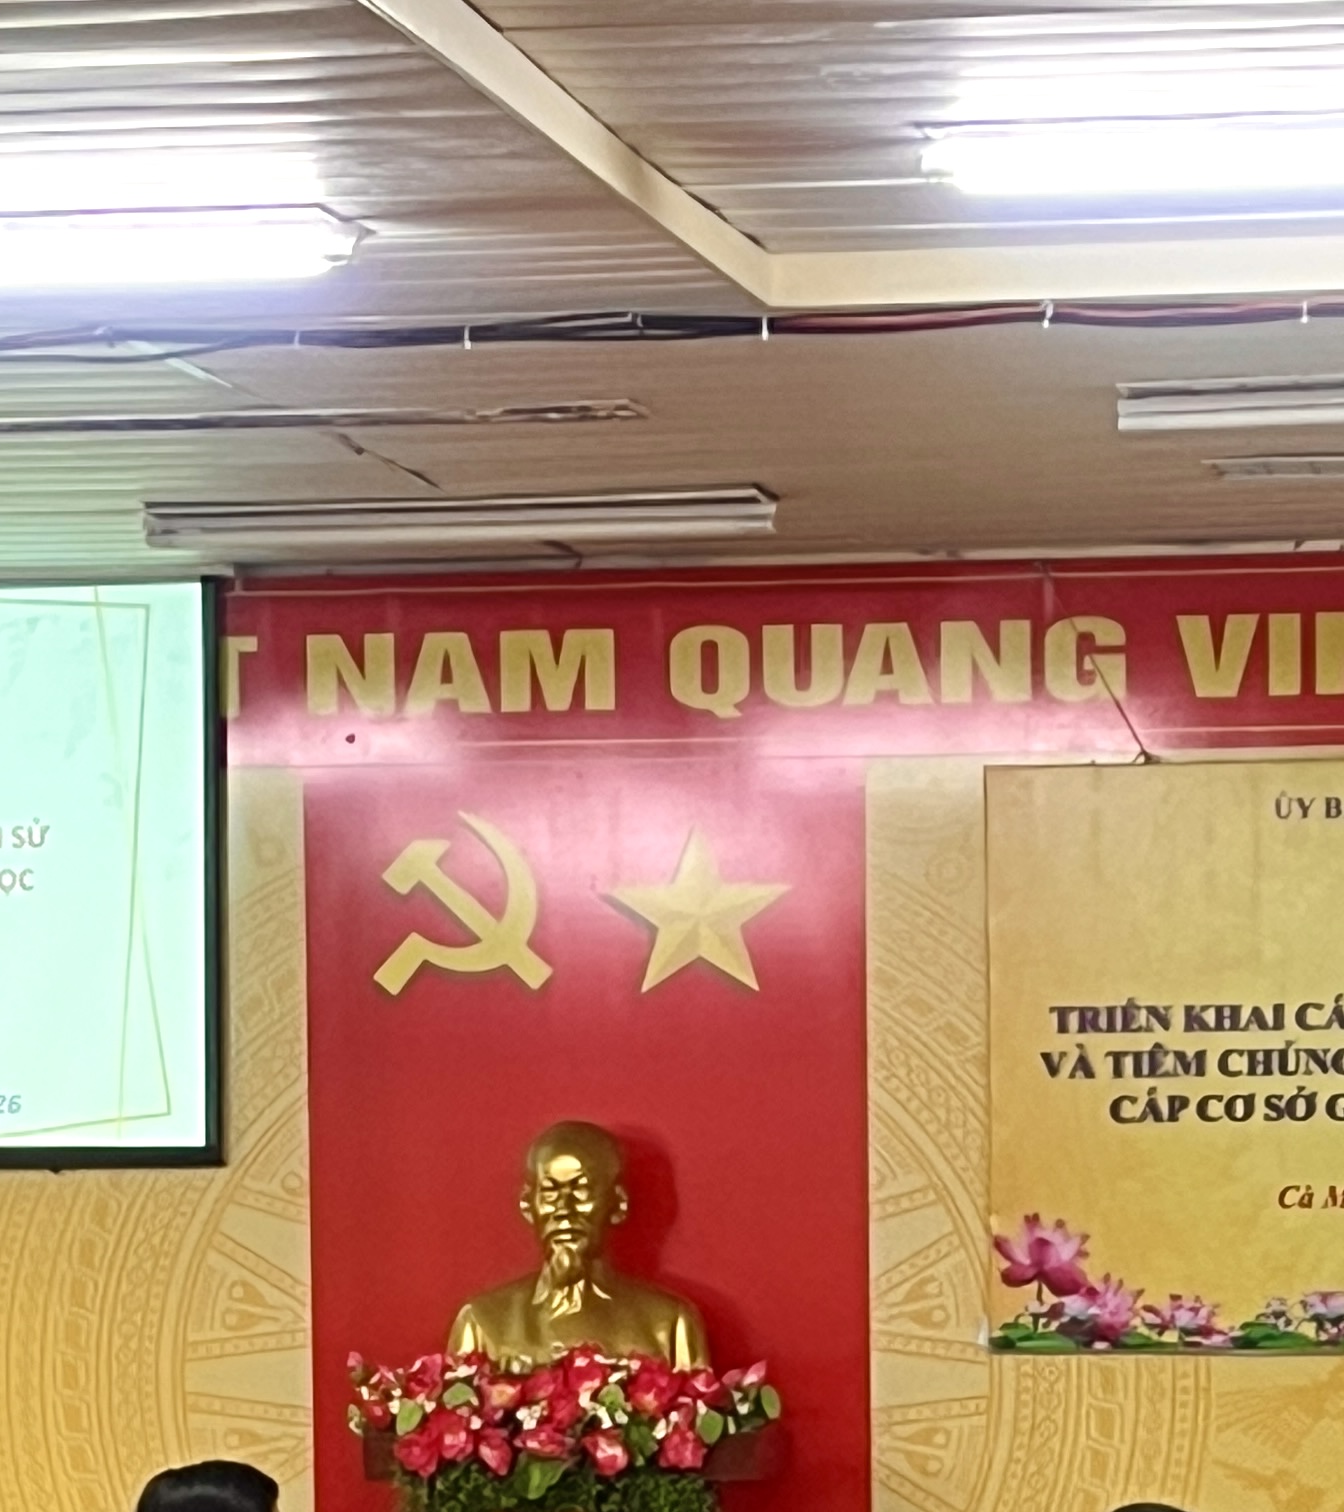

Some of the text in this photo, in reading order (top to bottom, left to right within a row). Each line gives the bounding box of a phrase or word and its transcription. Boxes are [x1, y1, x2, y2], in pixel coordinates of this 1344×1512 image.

[305, 627, 616, 717] NAM
[668, 615, 1127, 718] QUANG
[11, 817, 50, 849] SỬ
[1048, 996, 1174, 1033] TRIỂN
[1183, 1003, 1285, 1033] KHAI
[1039, 1042, 1096, 1079] VÀ
[1103, 1041, 1207, 1078] TIÊM
[1109, 1086, 1191, 1124] CẤP
[1196, 1092, 1256, 1123] CƠ
[1262, 1085, 1319, 1122] SỞ
[1277, 1184, 1315, 1210] Cà
